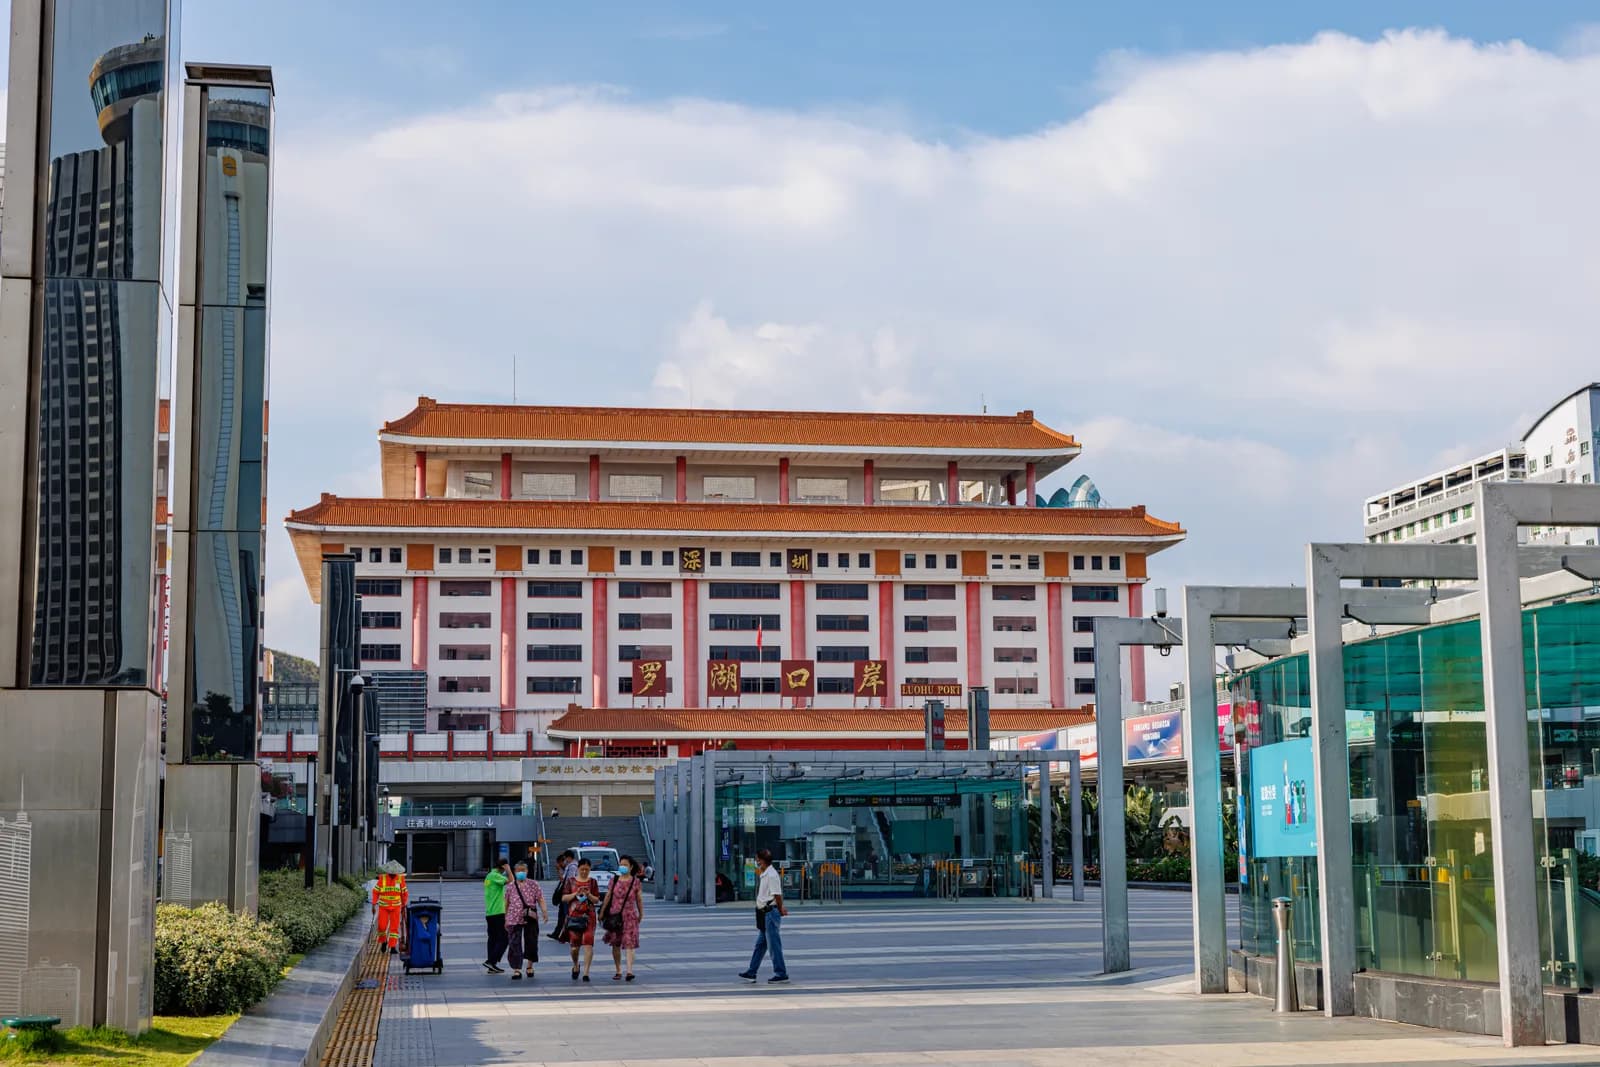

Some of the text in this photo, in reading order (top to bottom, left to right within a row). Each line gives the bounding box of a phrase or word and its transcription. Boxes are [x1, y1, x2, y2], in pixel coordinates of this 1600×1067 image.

[902, 685, 962, 695] LUOHU PORT
[406, 818, 477, 828] 往香港 HongKong
